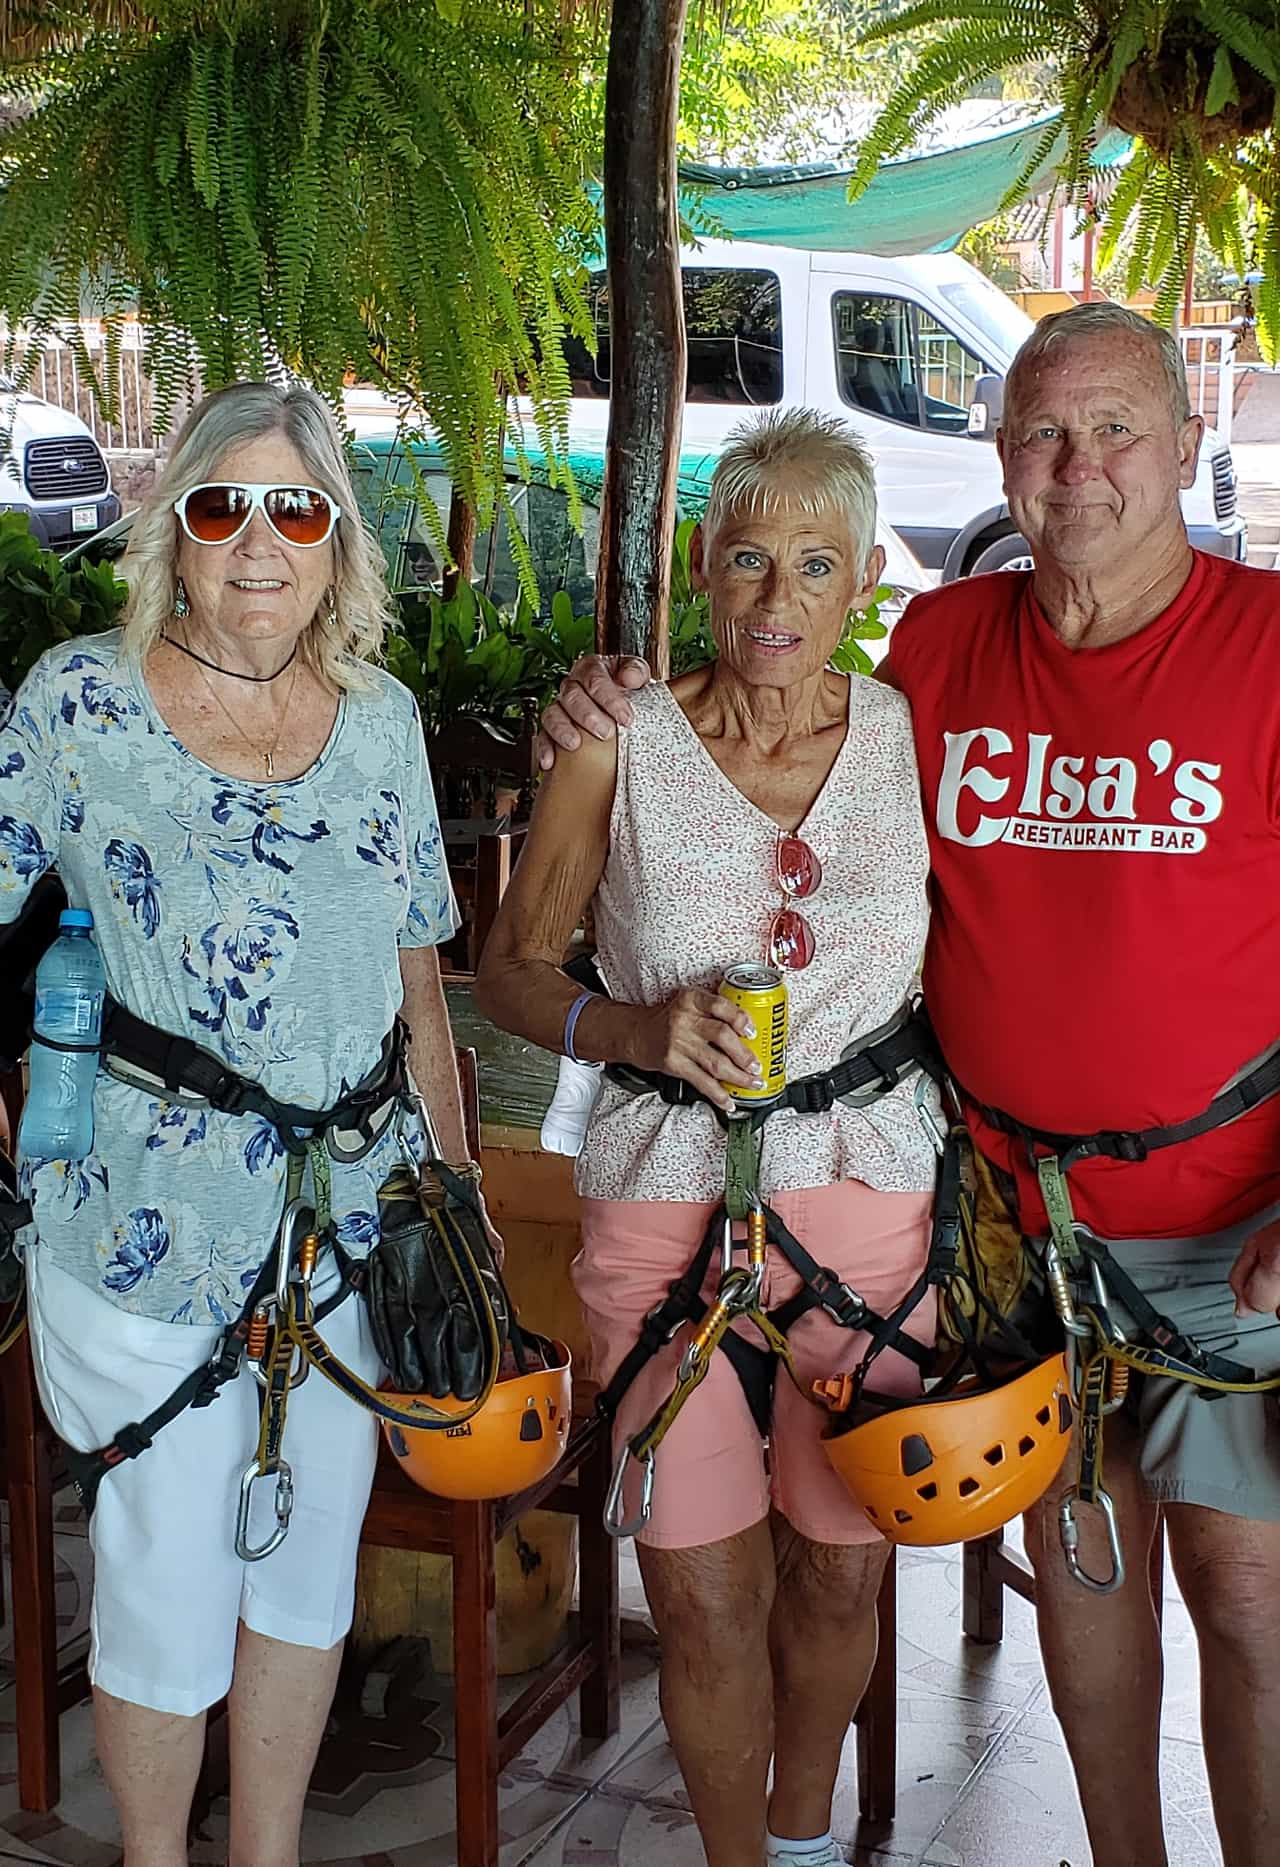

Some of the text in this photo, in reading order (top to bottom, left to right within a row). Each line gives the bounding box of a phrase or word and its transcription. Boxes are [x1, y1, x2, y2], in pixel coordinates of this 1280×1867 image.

[936, 727, 1223, 847] Elsa's
[1012, 822, 1195, 849] RESTAURANT BAR
[769, 1001, 785, 1078] PACIFICO
